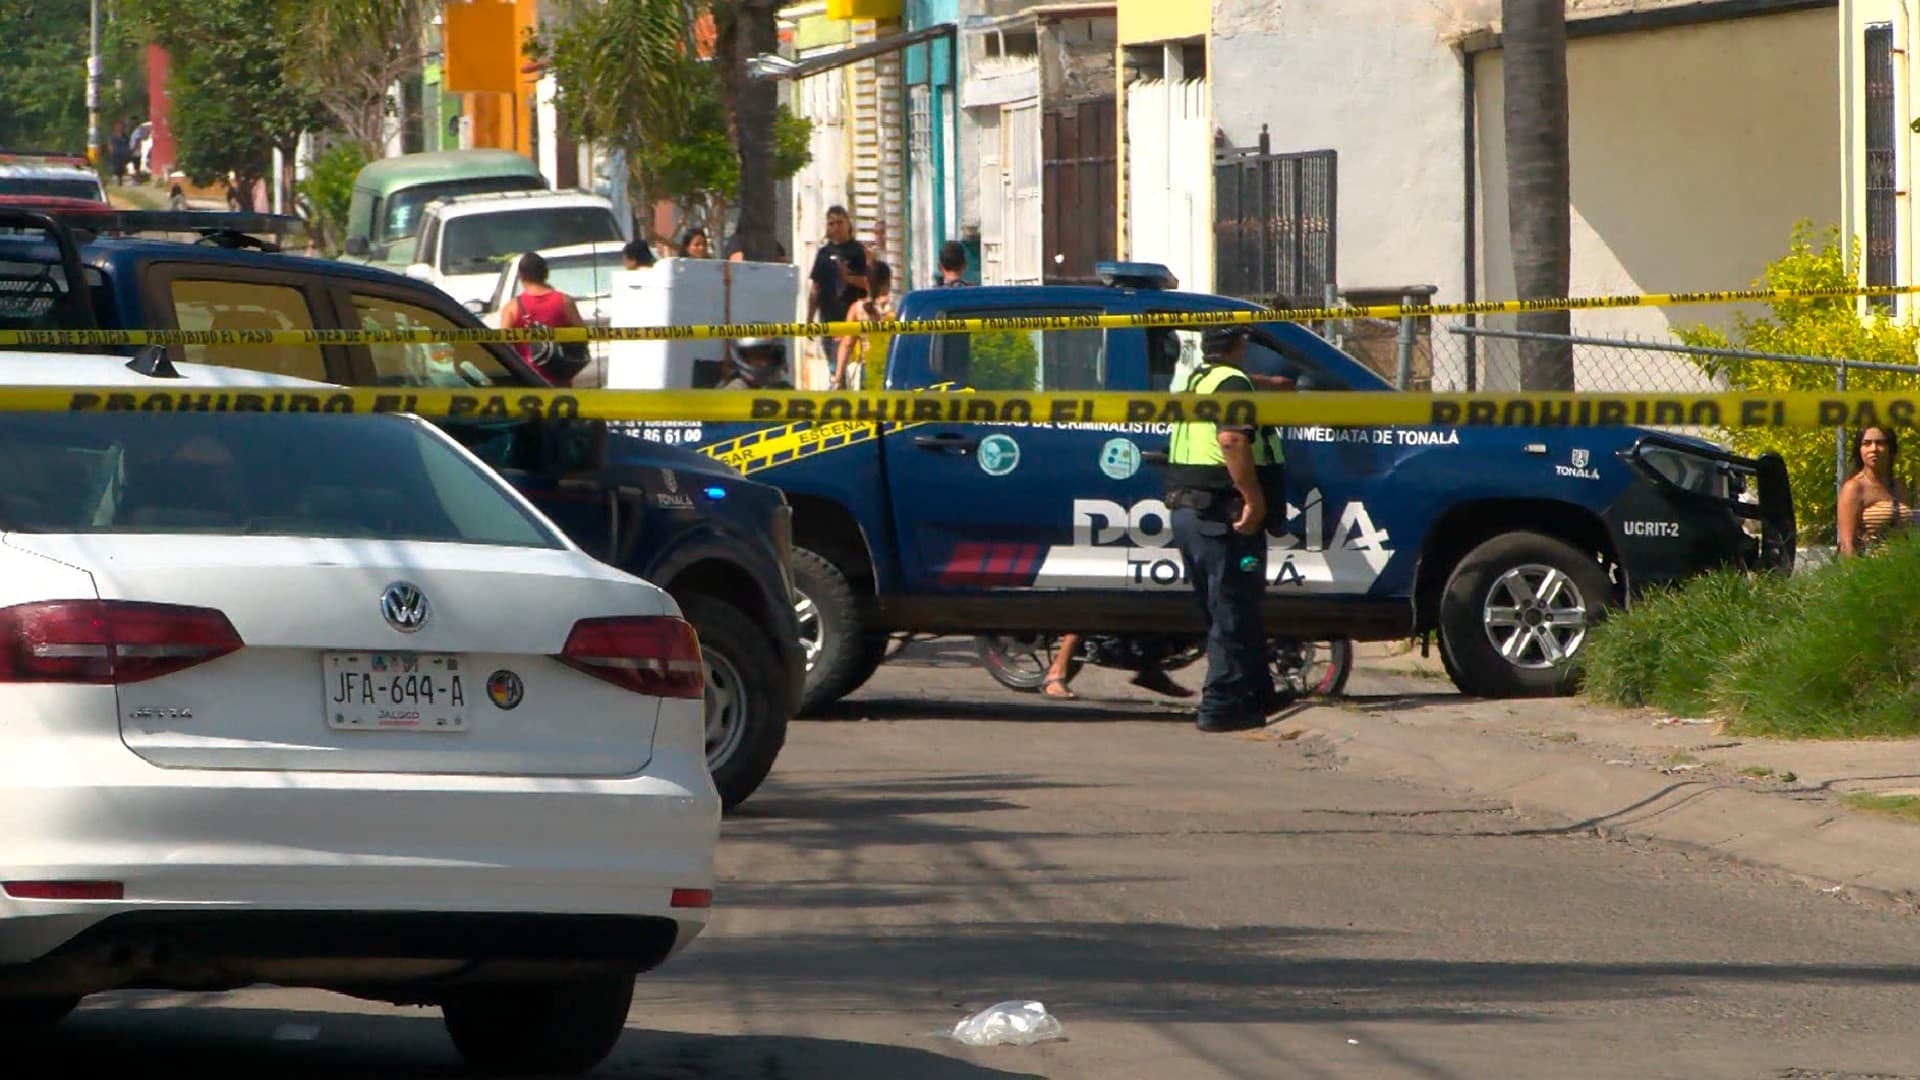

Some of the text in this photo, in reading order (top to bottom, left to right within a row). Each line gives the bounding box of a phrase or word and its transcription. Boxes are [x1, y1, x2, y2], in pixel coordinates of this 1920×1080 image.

[59, 331, 73, 344] DE
[146, 330, 218, 344] PROHIBIDO
[221, 330, 235, 343] EL
[240, 330, 273, 343] PASO
[346, 330, 360, 342] DE
[505, 329, 519, 341] EL
[586, 327, 622, 339] LINEA
[627, 327, 641, 339] DE
[781, 324, 795, 336] EL
[860, 320, 895, 333] LINEA
[901, 320, 915, 332] DE
[919, 319, 967, 332] POLICIA
[981, 317, 1047, 330] PROHIBIDO
[1051, 316, 1065, 328] EL
[1069, 315, 1100, 328] PASO
[1169, 312, 1183, 323] DE
[1818, 400, 1920, 425] PAS
[664, 428, 681, 444] 61
[684, 428, 702, 442] 00
[1287, 426, 1369, 443] INMEDIATA
[1372, 429, 1393, 444] DE
[1396, 428, 1460, 445] TONALÁ
[1555, 465, 1600, 480] TONALÁ
[334, 672, 464, 707] JFA-644-A
